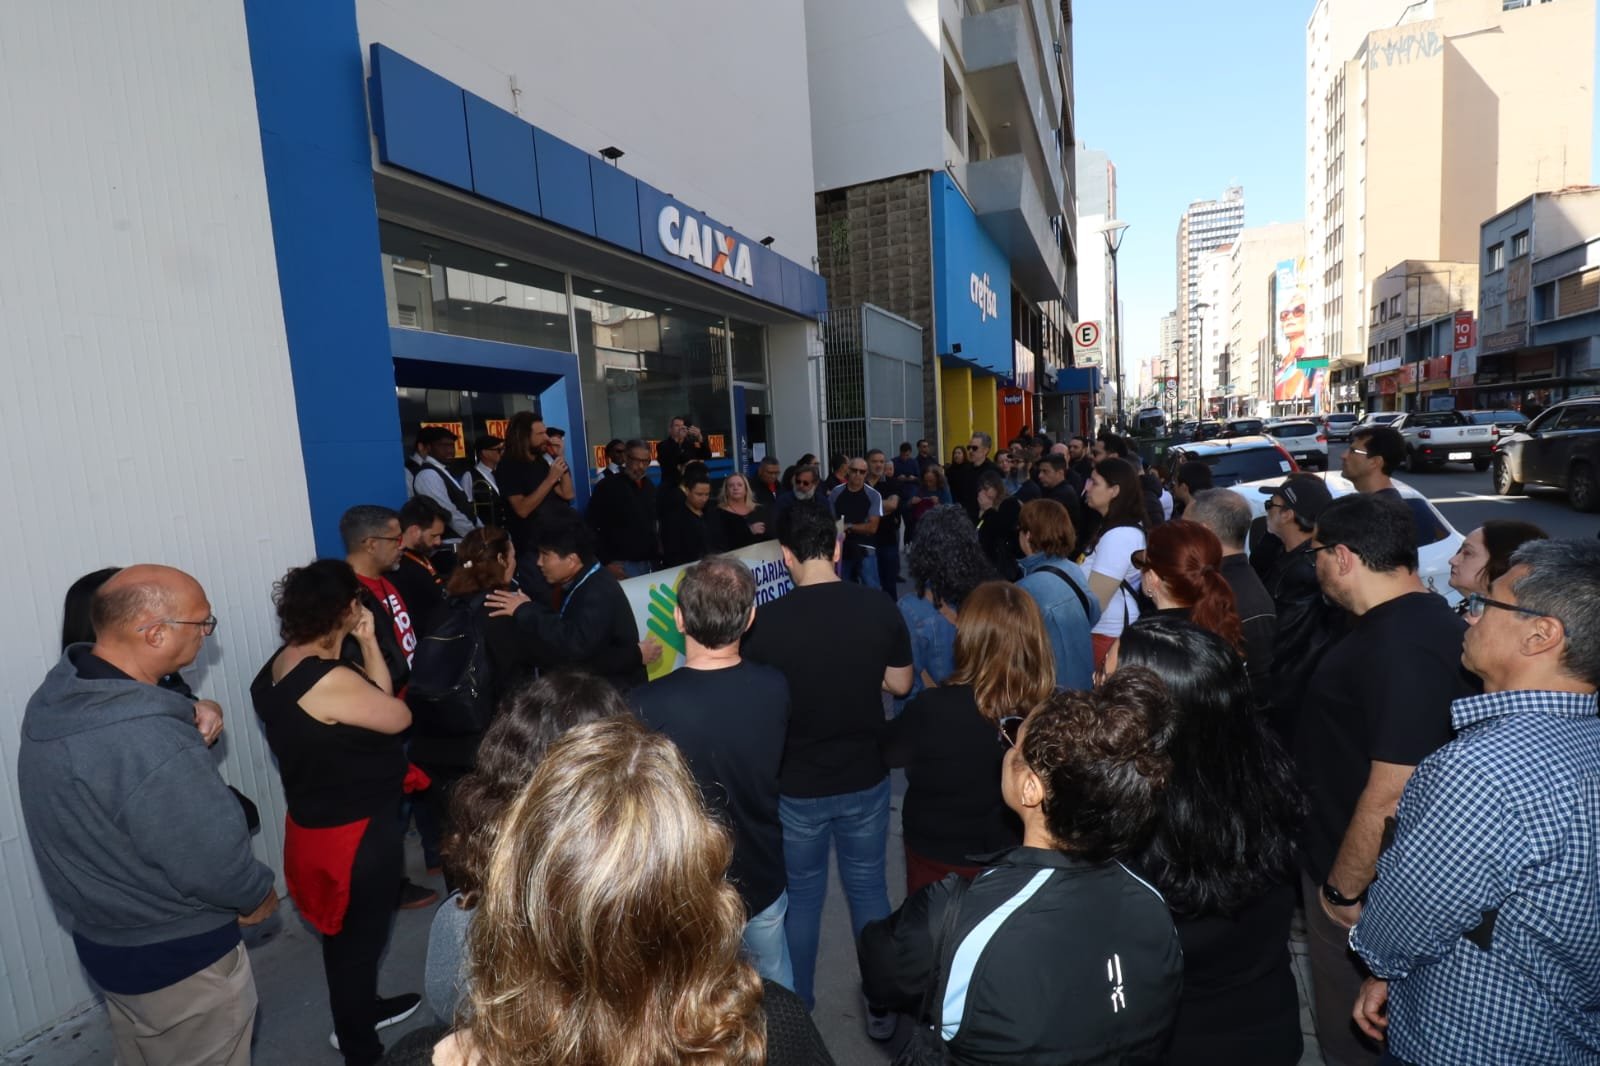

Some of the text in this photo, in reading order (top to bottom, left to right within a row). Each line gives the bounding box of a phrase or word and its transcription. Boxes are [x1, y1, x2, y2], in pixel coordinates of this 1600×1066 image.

[658, 205, 754, 288] CAIXA
[1082, 327, 1091, 342] E
[1455, 323, 1470, 334] 10
[752, 560, 789, 586] CÁRIAS
